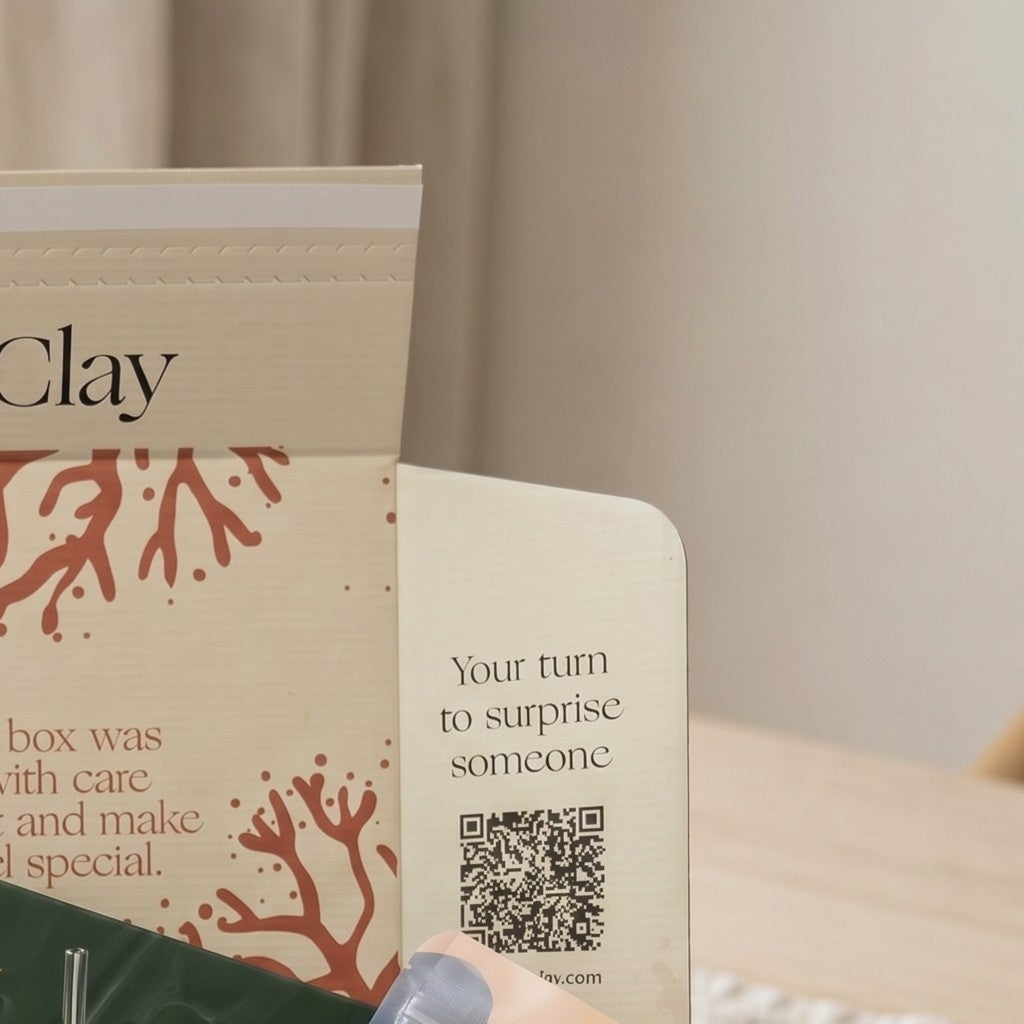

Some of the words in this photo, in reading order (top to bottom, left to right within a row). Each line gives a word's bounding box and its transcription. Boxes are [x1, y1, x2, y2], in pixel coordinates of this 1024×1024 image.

[451, 655, 526, 686] Your
[539, 651, 608, 679] turn
[440, 707, 472, 733] to
[486, 693, 624, 736] surprise
[8, 718, 78, 754] box
[89, 726, 163, 752] was
[451, 745, 613, 778] someone
[73, 768, 153, 795] care
[16, 805, 86, 839] and
[100, 800, 205, 835] make
[27, 842, 163, 889] special.
